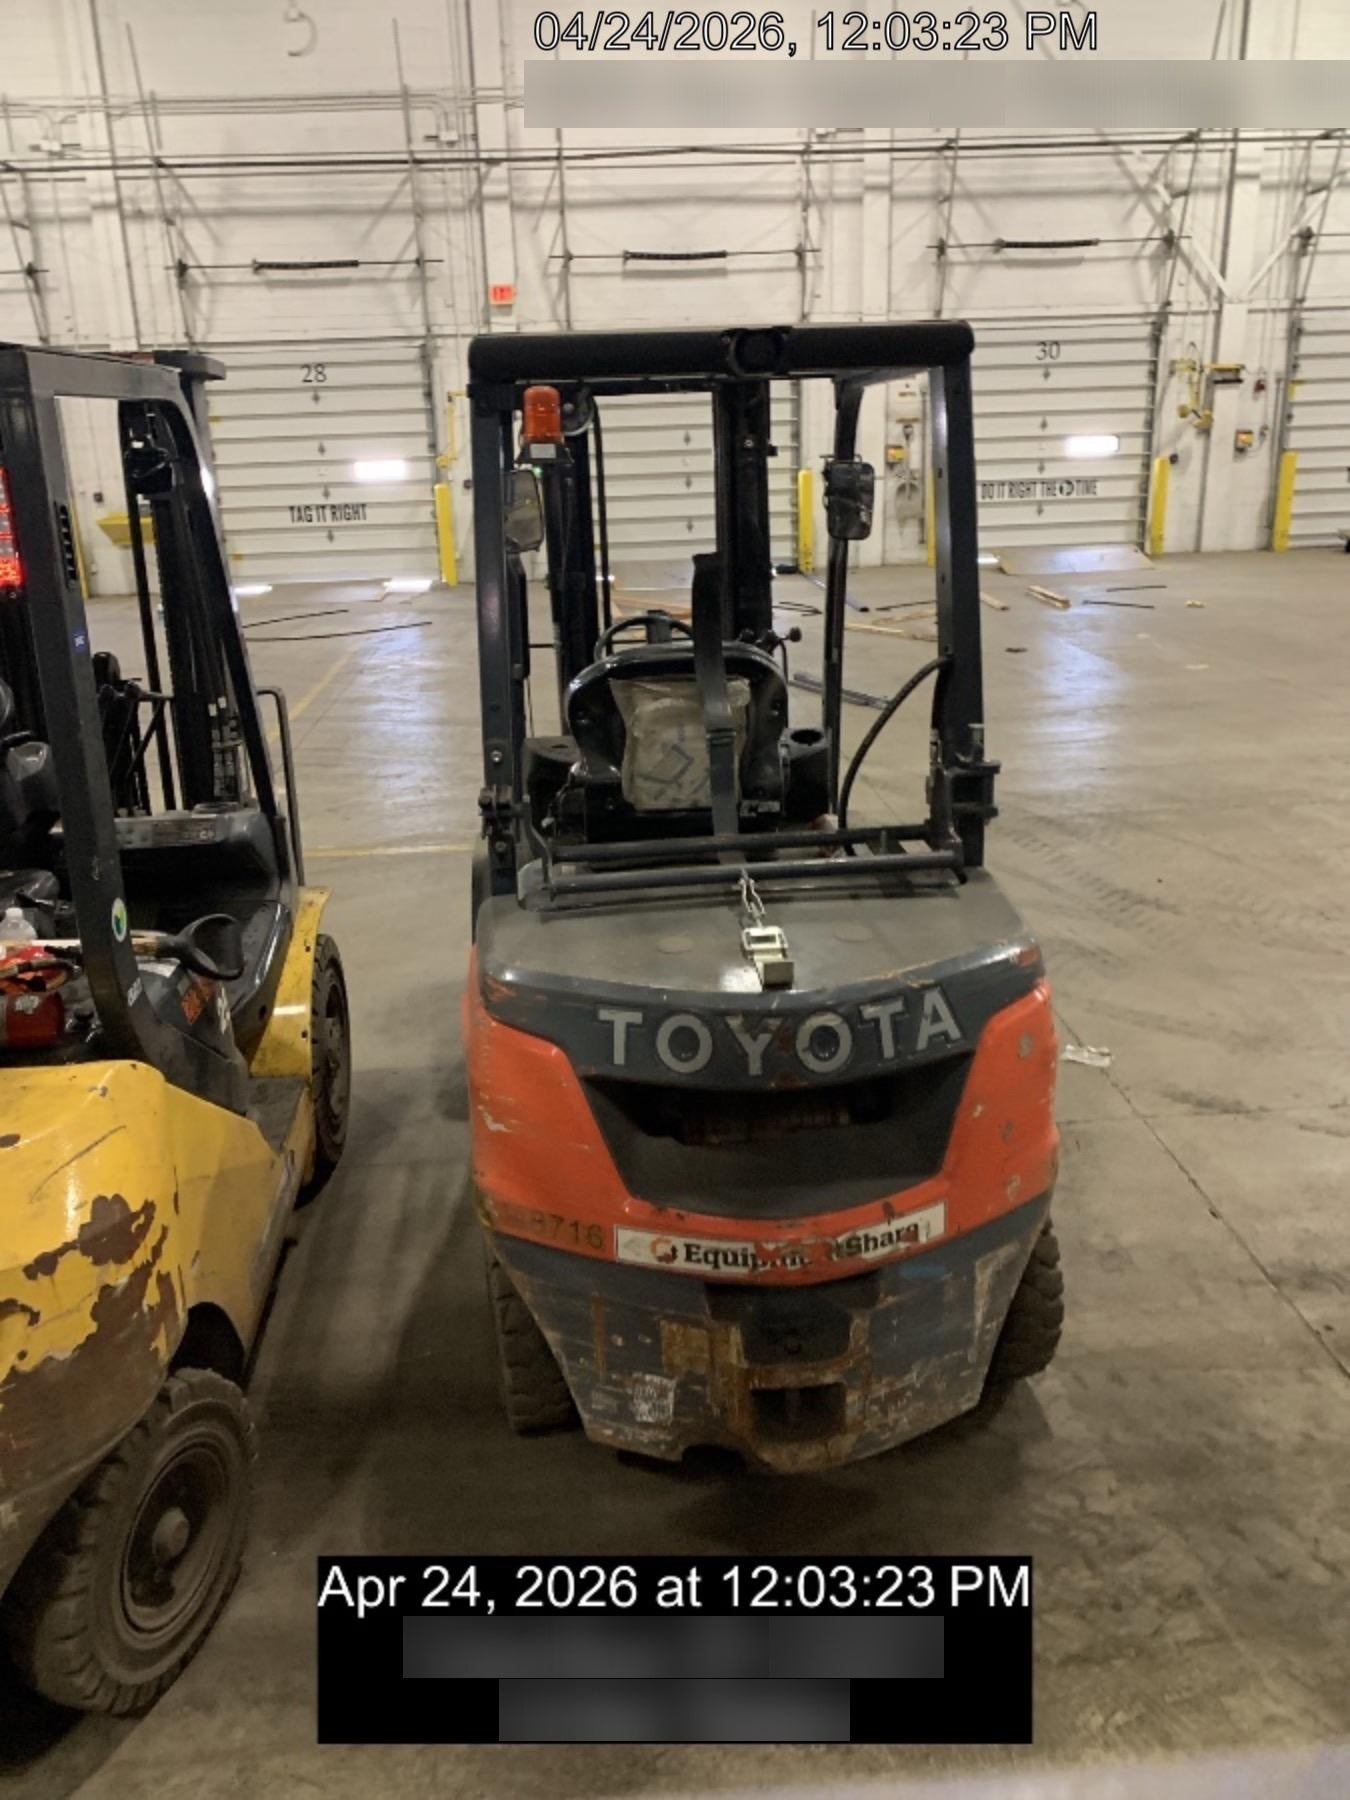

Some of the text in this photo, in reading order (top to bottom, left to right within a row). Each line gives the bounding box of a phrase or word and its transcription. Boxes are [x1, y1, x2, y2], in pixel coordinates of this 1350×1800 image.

[1035, 341, 1060, 361] 30
[301, 363, 327, 383] 28
[1008, 480, 1037, 499] RIGHT
[288, 503, 367, 523] TAG IT RIGHT
[597, 989, 962, 1077] TOYOTA
